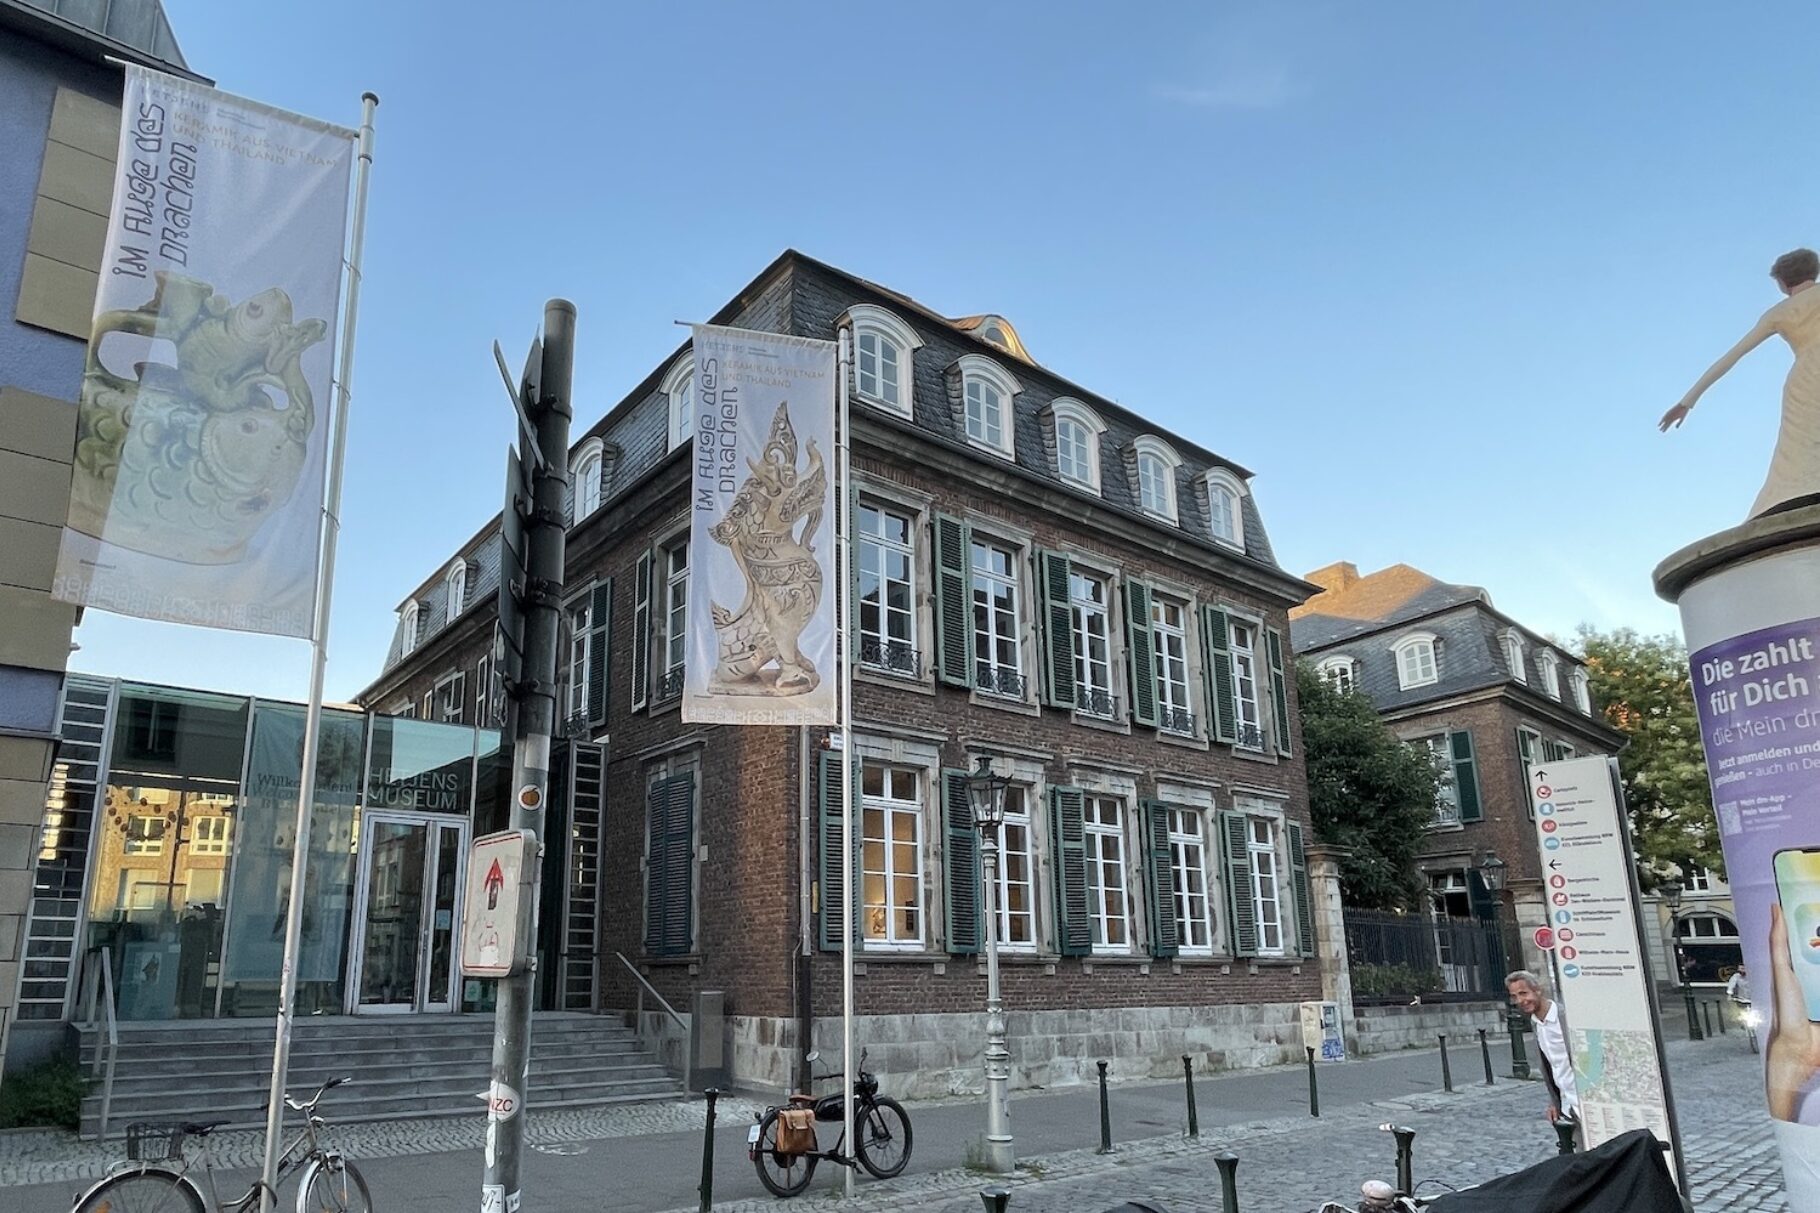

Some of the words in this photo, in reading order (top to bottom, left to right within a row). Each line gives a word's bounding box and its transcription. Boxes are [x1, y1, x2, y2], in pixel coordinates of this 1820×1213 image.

[213, 138, 285, 165] THAILAND
[243, 134, 271, 148] AUS
[275, 143, 336, 167] VIETNAM
[1701, 657, 1735, 687] Die
[1738, 637, 1815, 675] zahlt
[1710, 690, 1738, 716] für
[1743, 672, 1809, 707] Dich
[1713, 727, 1734, 746] die
[1736, 715, 1786, 740] Mein
[1736, 747, 1791, 765] anmelden
[1755, 763, 1784, 777] auch
[1786, 761, 1799, 772] in
[367, 785, 458, 810] MUSEUM
